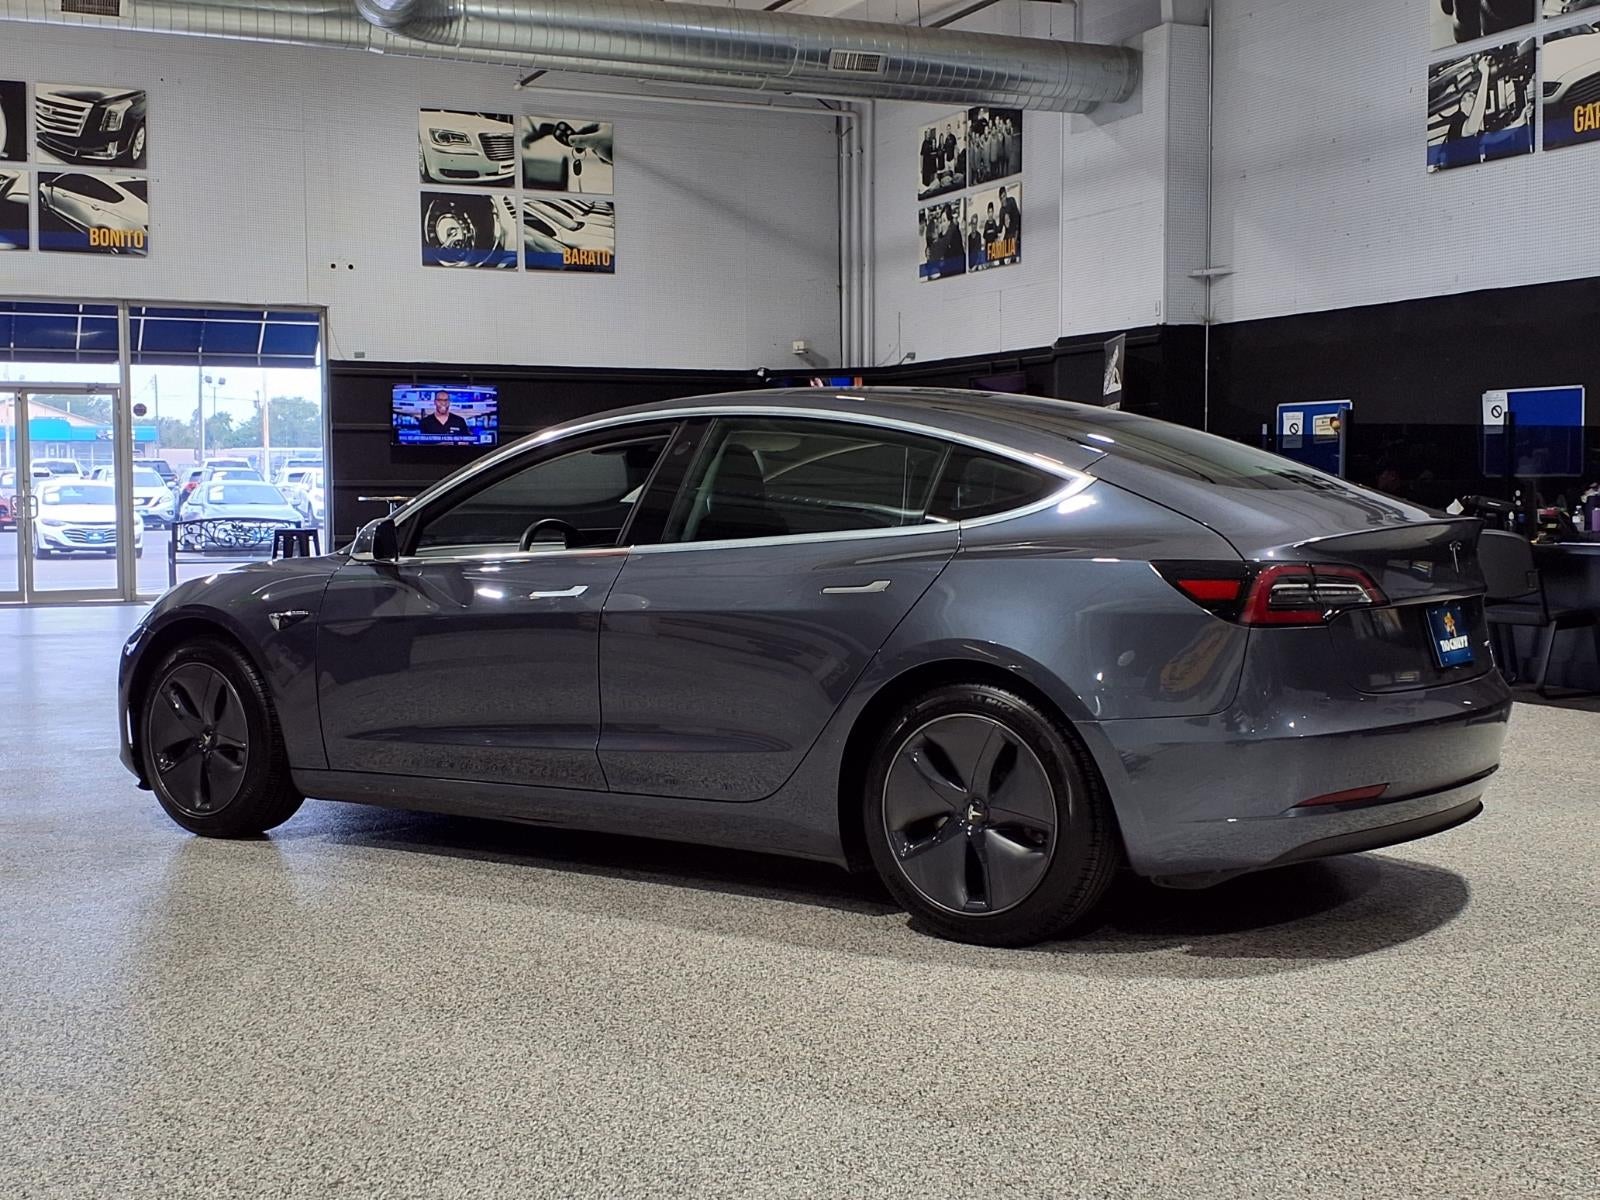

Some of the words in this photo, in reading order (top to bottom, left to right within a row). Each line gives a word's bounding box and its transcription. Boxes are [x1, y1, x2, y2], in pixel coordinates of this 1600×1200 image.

[90, 227, 144, 248] BONITO
[563, 247, 610, 266] BARATO
[987, 237, 1016, 261] FAMILIA
